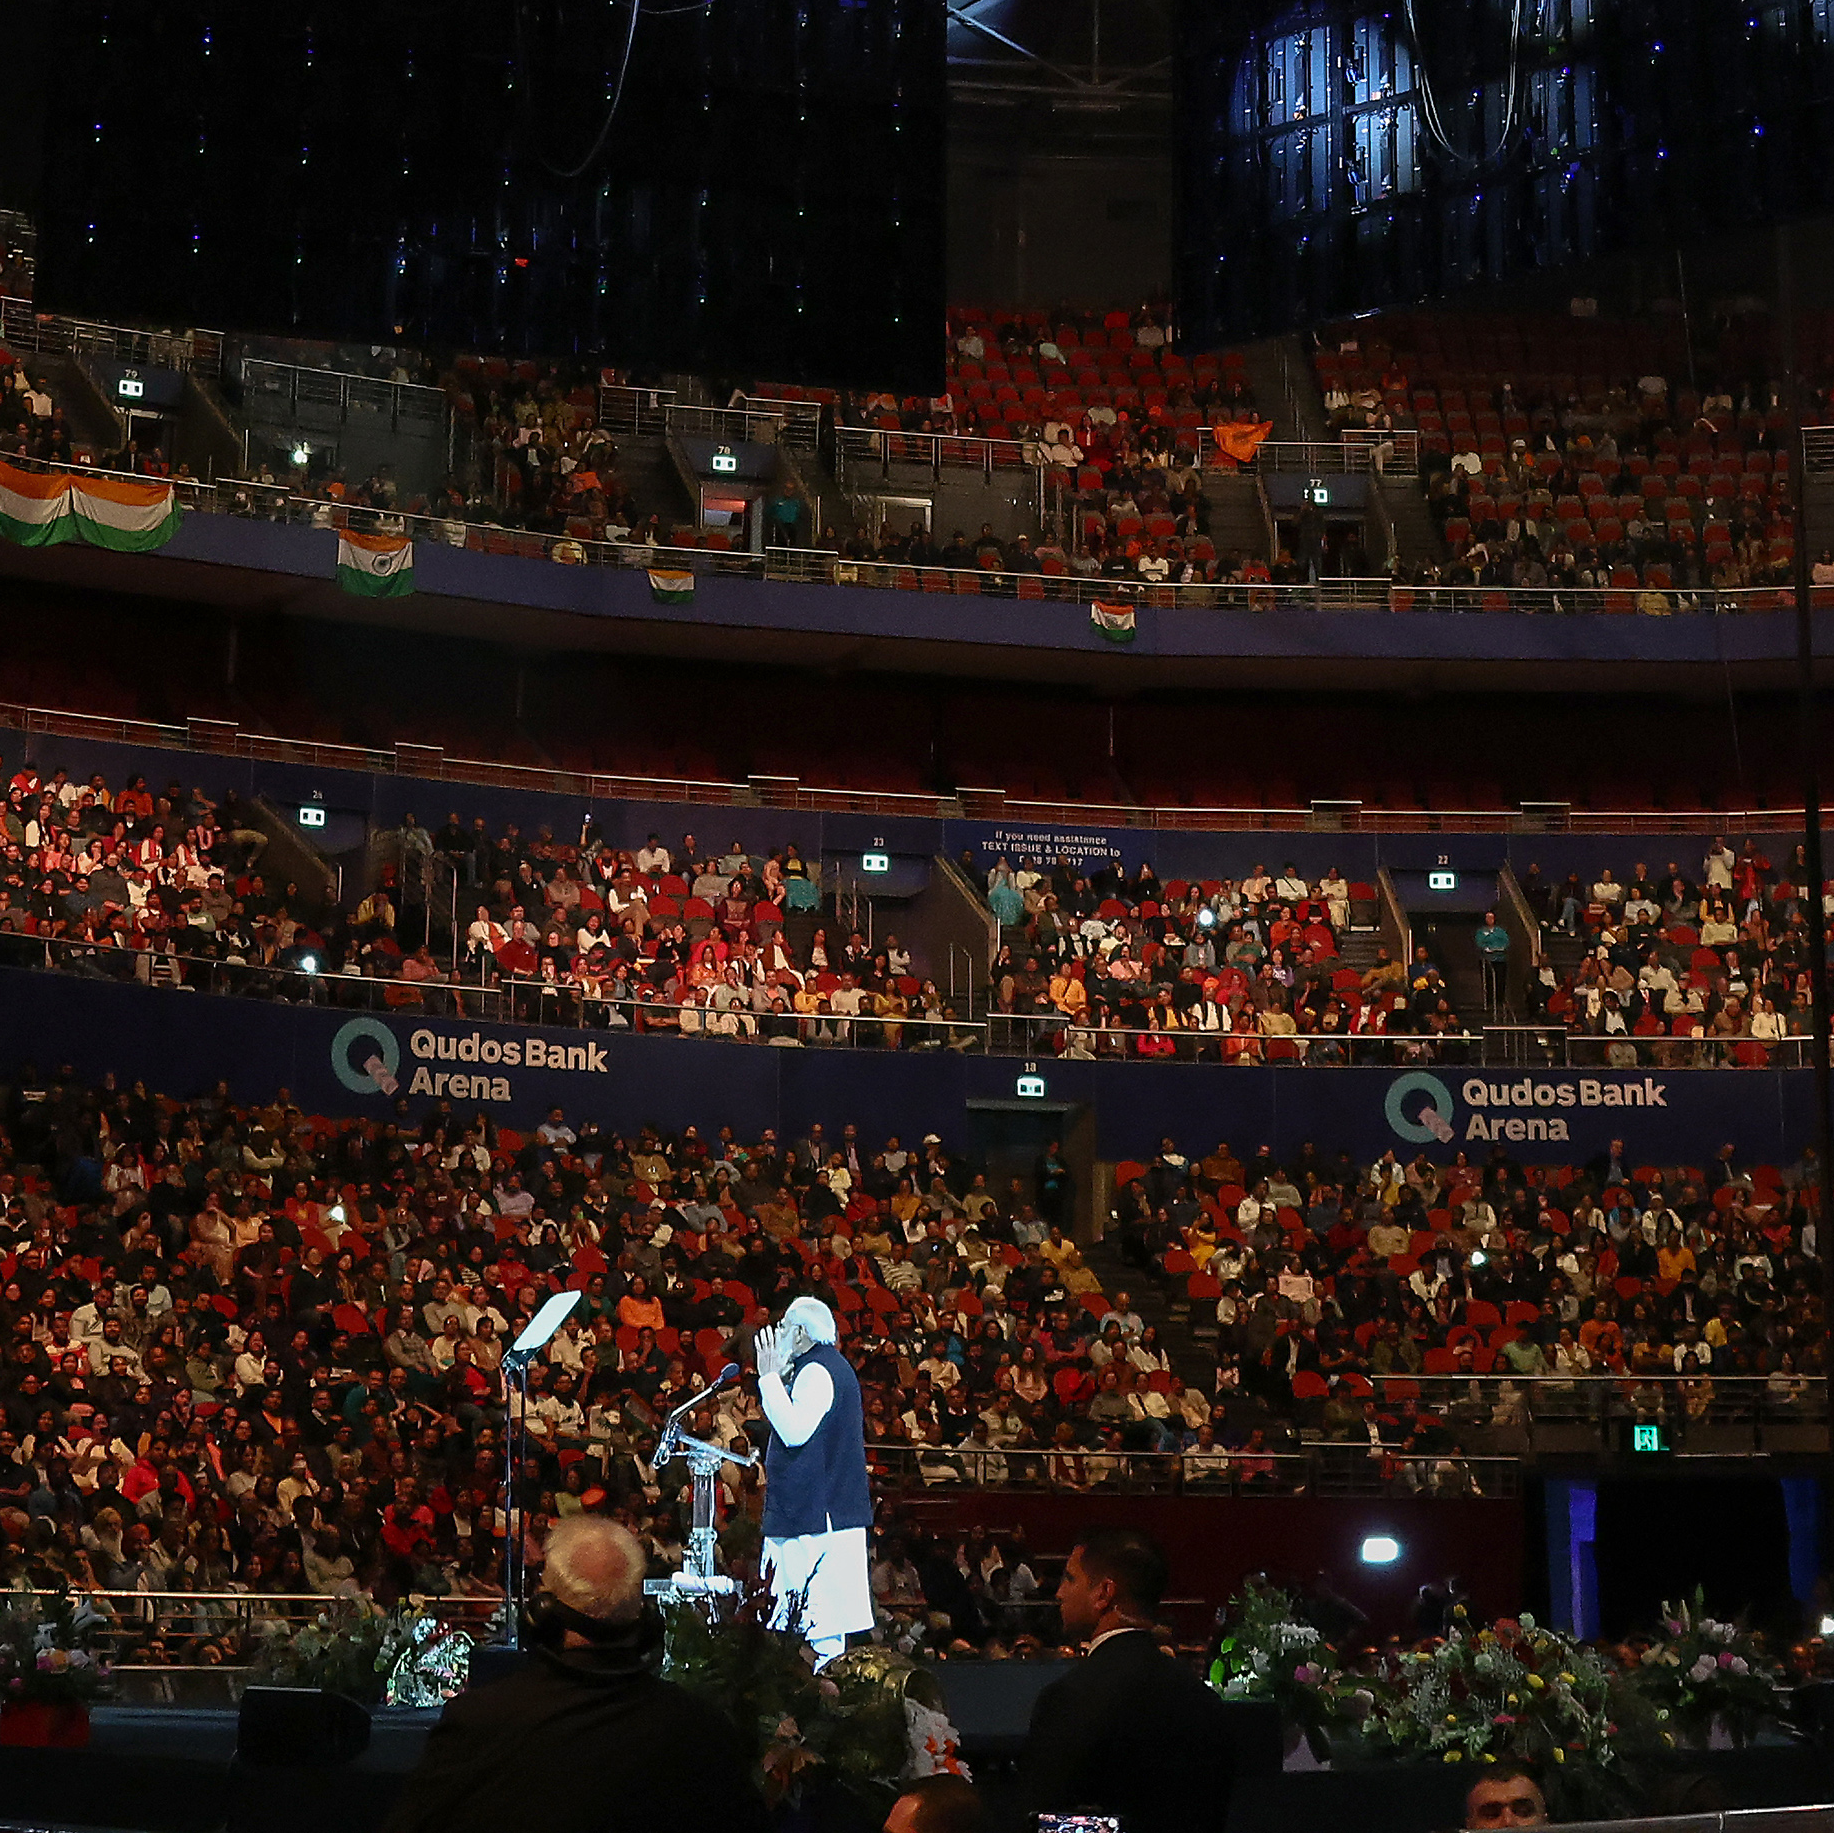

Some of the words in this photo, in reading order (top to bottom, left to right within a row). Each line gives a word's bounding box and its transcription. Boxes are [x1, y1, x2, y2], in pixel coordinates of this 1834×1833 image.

[1309, 478, 1322, 487] 77
[982, 841, 1008, 851] TEXT
[1055, 845, 1108, 856] LOCATION
[994, 830, 1003, 840] If
[1005, 832, 1024, 842] you
[410, 1028, 522, 1065] Qudos
[525, 1037, 610, 1073] Bank
[408, 1066, 512, 1102] Arena
[1462, 1077, 1577, 1107] Qudos
[1579, 1077, 1667, 1107] Bank
[1466, 1113, 1570, 1142] Arena
